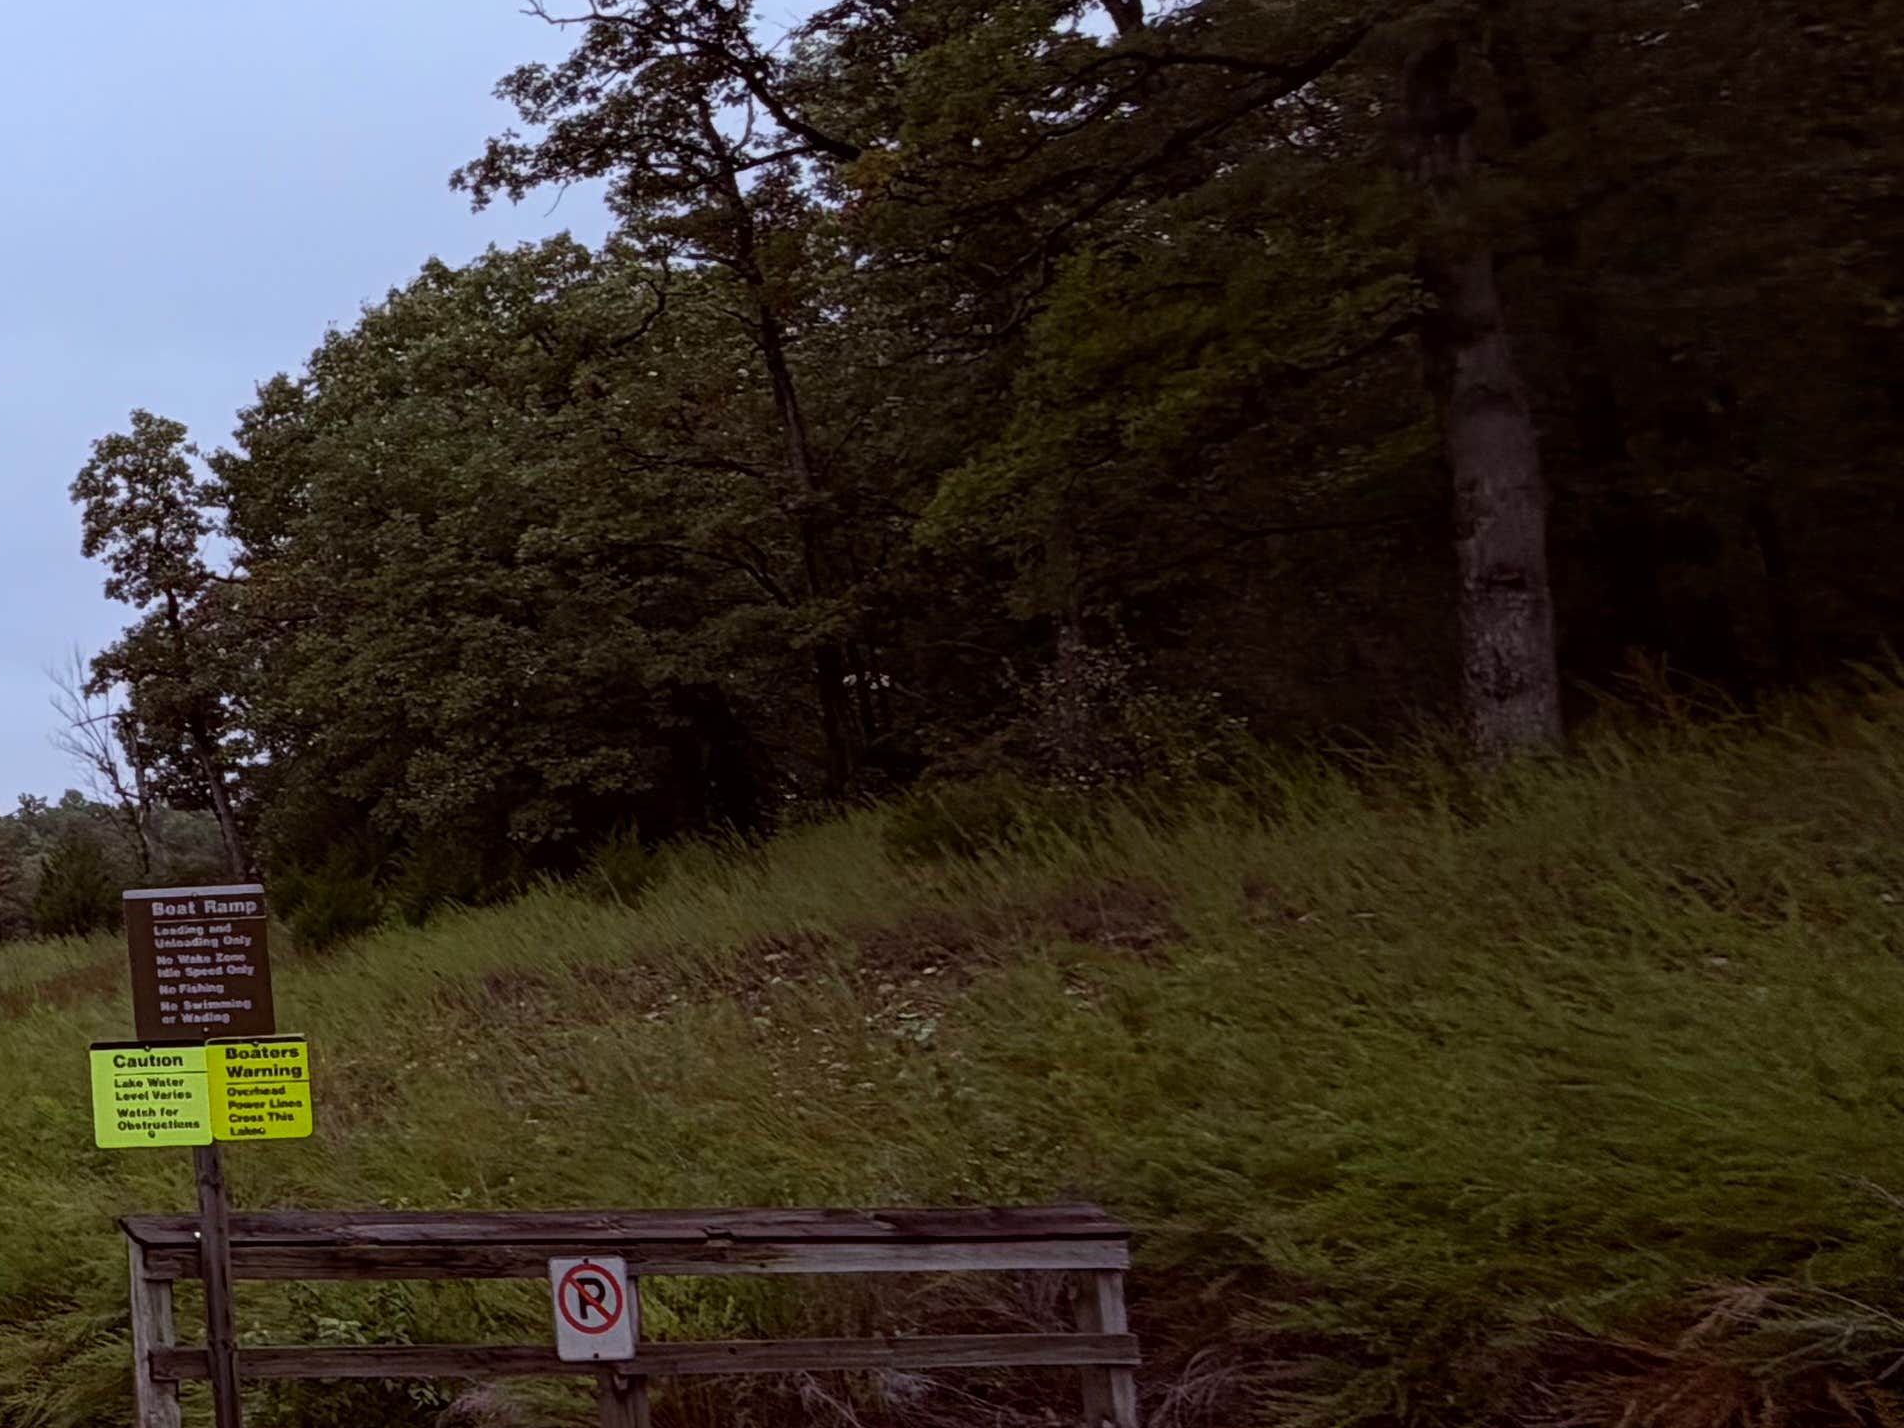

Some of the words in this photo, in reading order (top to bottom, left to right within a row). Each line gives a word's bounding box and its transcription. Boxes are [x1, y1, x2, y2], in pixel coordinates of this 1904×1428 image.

[152, 901, 195, 916] Boat
[204, 900, 257, 914] Ramp
[153, 925, 204, 936] Loading
[209, 923, 231, 933] and
[155, 937, 218, 948] Unloading
[223, 935, 252, 946] Only
[156, 956, 173, 964] No
[177, 954, 211, 963] Wake
[216, 953, 246, 962] Zone
[158, 968, 180, 977] Idle
[185, 966, 223, 977] Speed
[227, 965, 254, 975] Only
[159, 985, 176, 995] No
[179, 984, 224, 994] Fishing
[160, 1002, 178, 1011] No
[184, 999, 251, 1010] Swimming
[162, 1016, 176, 1024] or
[181, 1013, 230, 1023] Wading
[226, 1048, 300, 1060] Boaters
[113, 1055, 183, 1068] Caution
[226, 1065, 302, 1079] Warning
[114, 1079, 143, 1088] Lake
[147, 1078, 184, 1087] Water
[116, 1091, 149, 1100] Level
[152, 1090, 192, 1099] Varies
[227, 1086, 286, 1096] Overhead
[228, 1101, 265, 1109] Power
[270, 1099, 302, 1108] Lines
[117, 1108, 156, 1117] Watch
[160, 1108, 178, 1116] for
[229, 1114, 264, 1122] Cross
[267, 1112, 294, 1121] This
[118, 1120, 200, 1130] Obstructions
